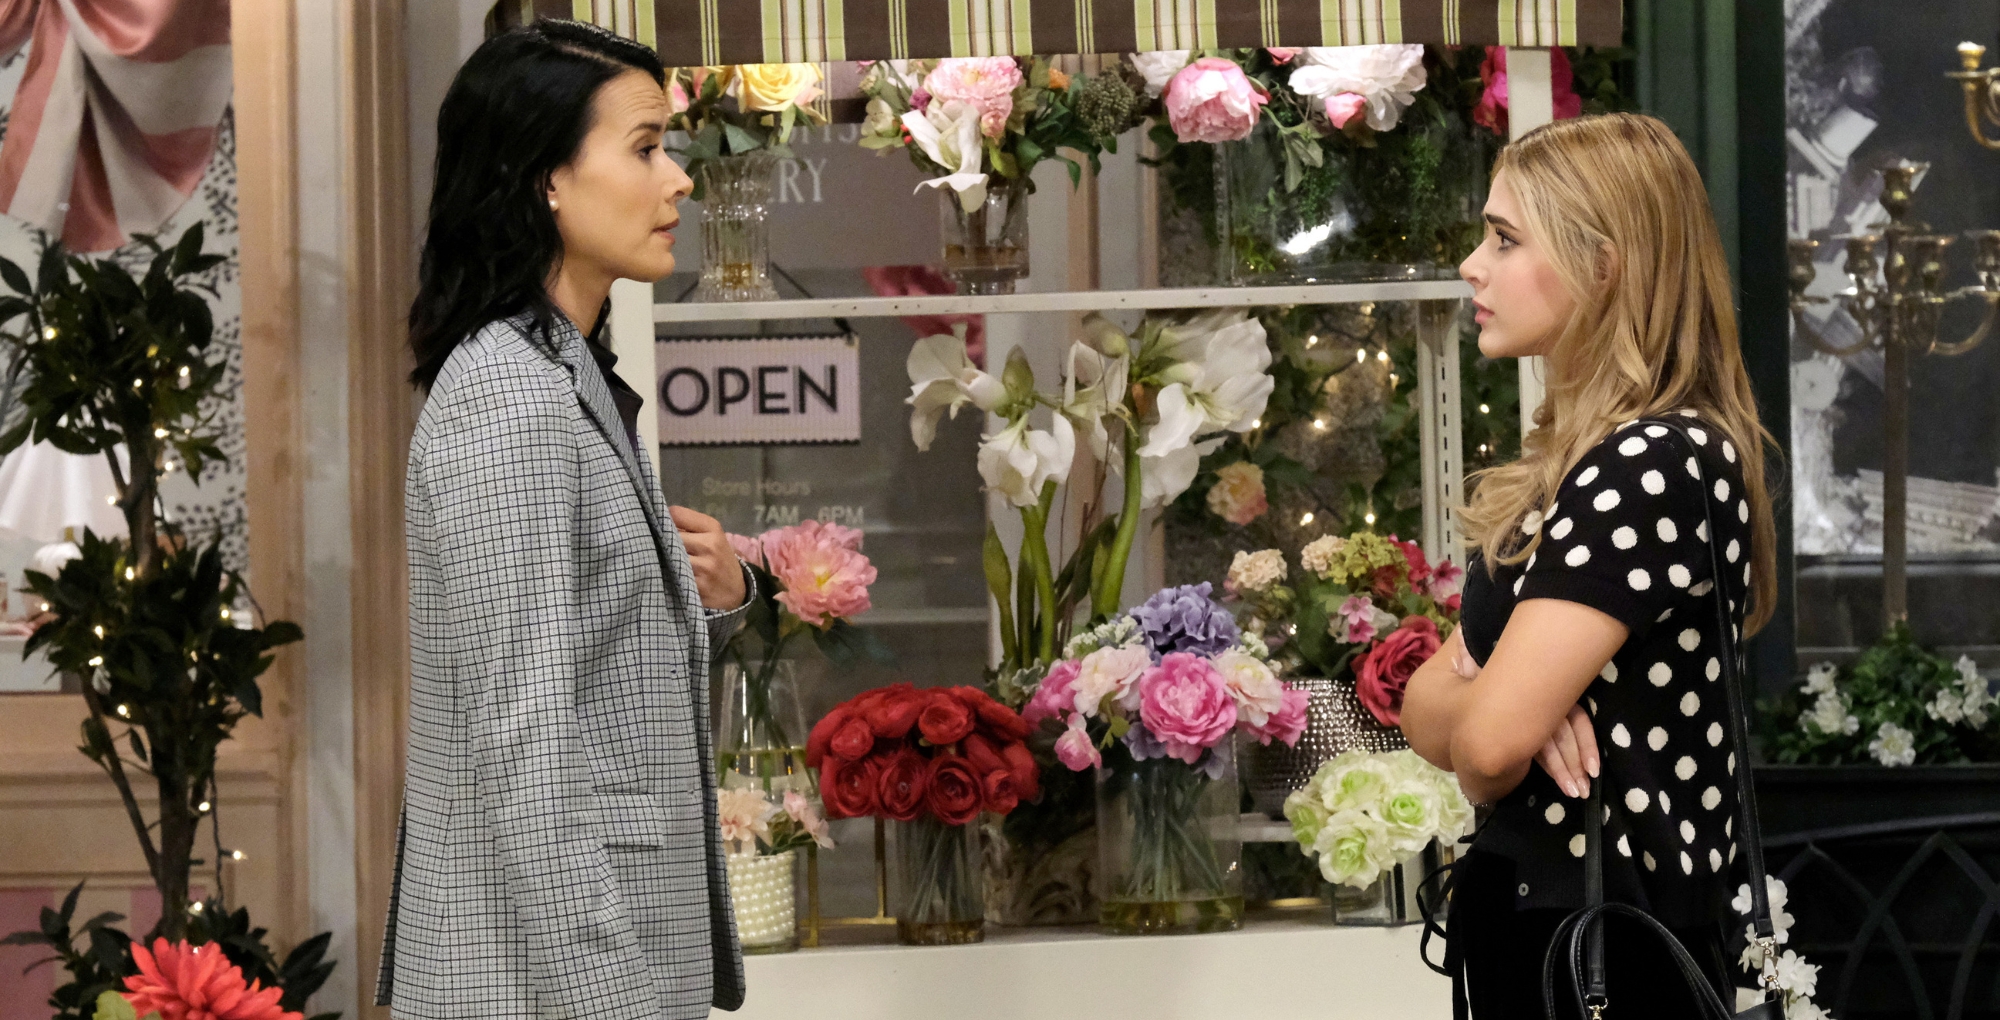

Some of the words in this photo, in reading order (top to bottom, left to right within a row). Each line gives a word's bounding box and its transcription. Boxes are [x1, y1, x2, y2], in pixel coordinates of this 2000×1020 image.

[766, 157, 829, 203] RY
[658, 364, 838, 417] OPEN
[702, 476, 750, 496] Store
[756, 476, 811, 496] Hours
[754, 504, 799, 524] 7AM
[817, 504, 865, 524] 6PM
